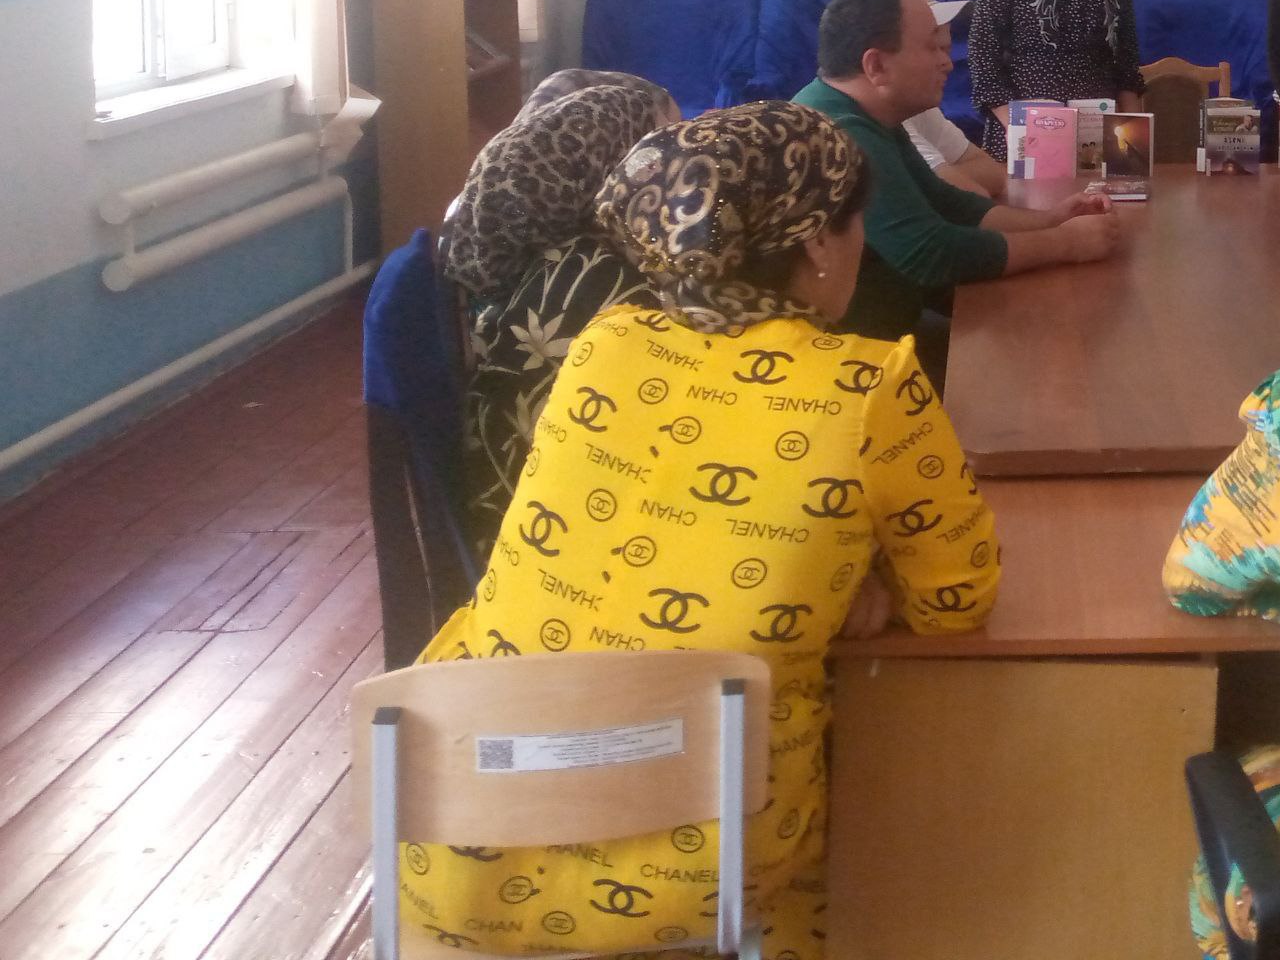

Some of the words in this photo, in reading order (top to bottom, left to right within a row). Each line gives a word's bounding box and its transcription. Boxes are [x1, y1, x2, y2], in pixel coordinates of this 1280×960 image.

[686, 385, 738, 406] CHAN
[763, 395, 842, 415] CHANEL
[870, 422, 933, 465] CHANEL
[640, 498, 697, 527] CHAN
[726, 518, 810, 544] CHANEL
[589, 626, 646, 652] CHAN
[463, 917, 523, 932] CHAN
